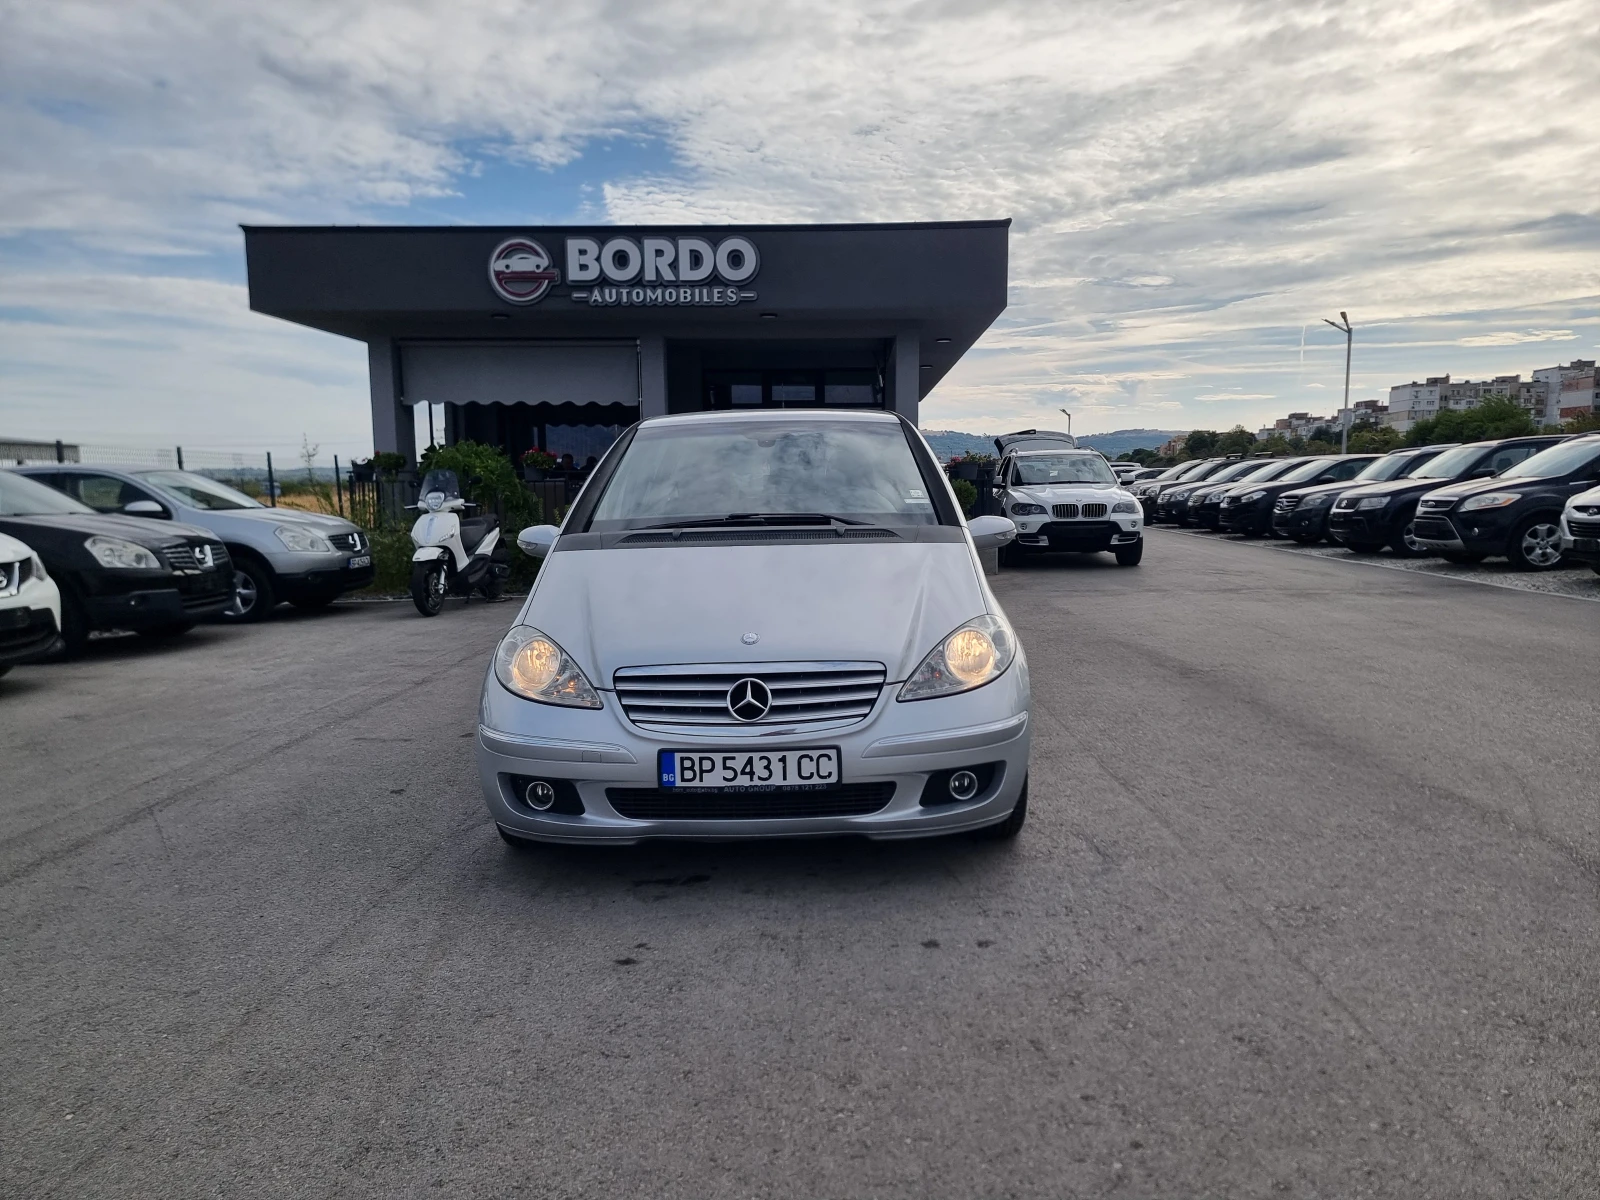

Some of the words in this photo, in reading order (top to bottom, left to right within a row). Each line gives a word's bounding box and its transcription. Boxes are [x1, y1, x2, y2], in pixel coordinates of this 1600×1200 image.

[566, 238, 757, 282] BORDO
[591, 288, 738, 303] AUTOMOBILES
[679, 756, 716, 782] BP
[721, 755, 787, 782] 5431
[797, 754, 833, 780] CC
[662, 773, 675, 782] BG
[748, 784, 776, 792] GROUP
